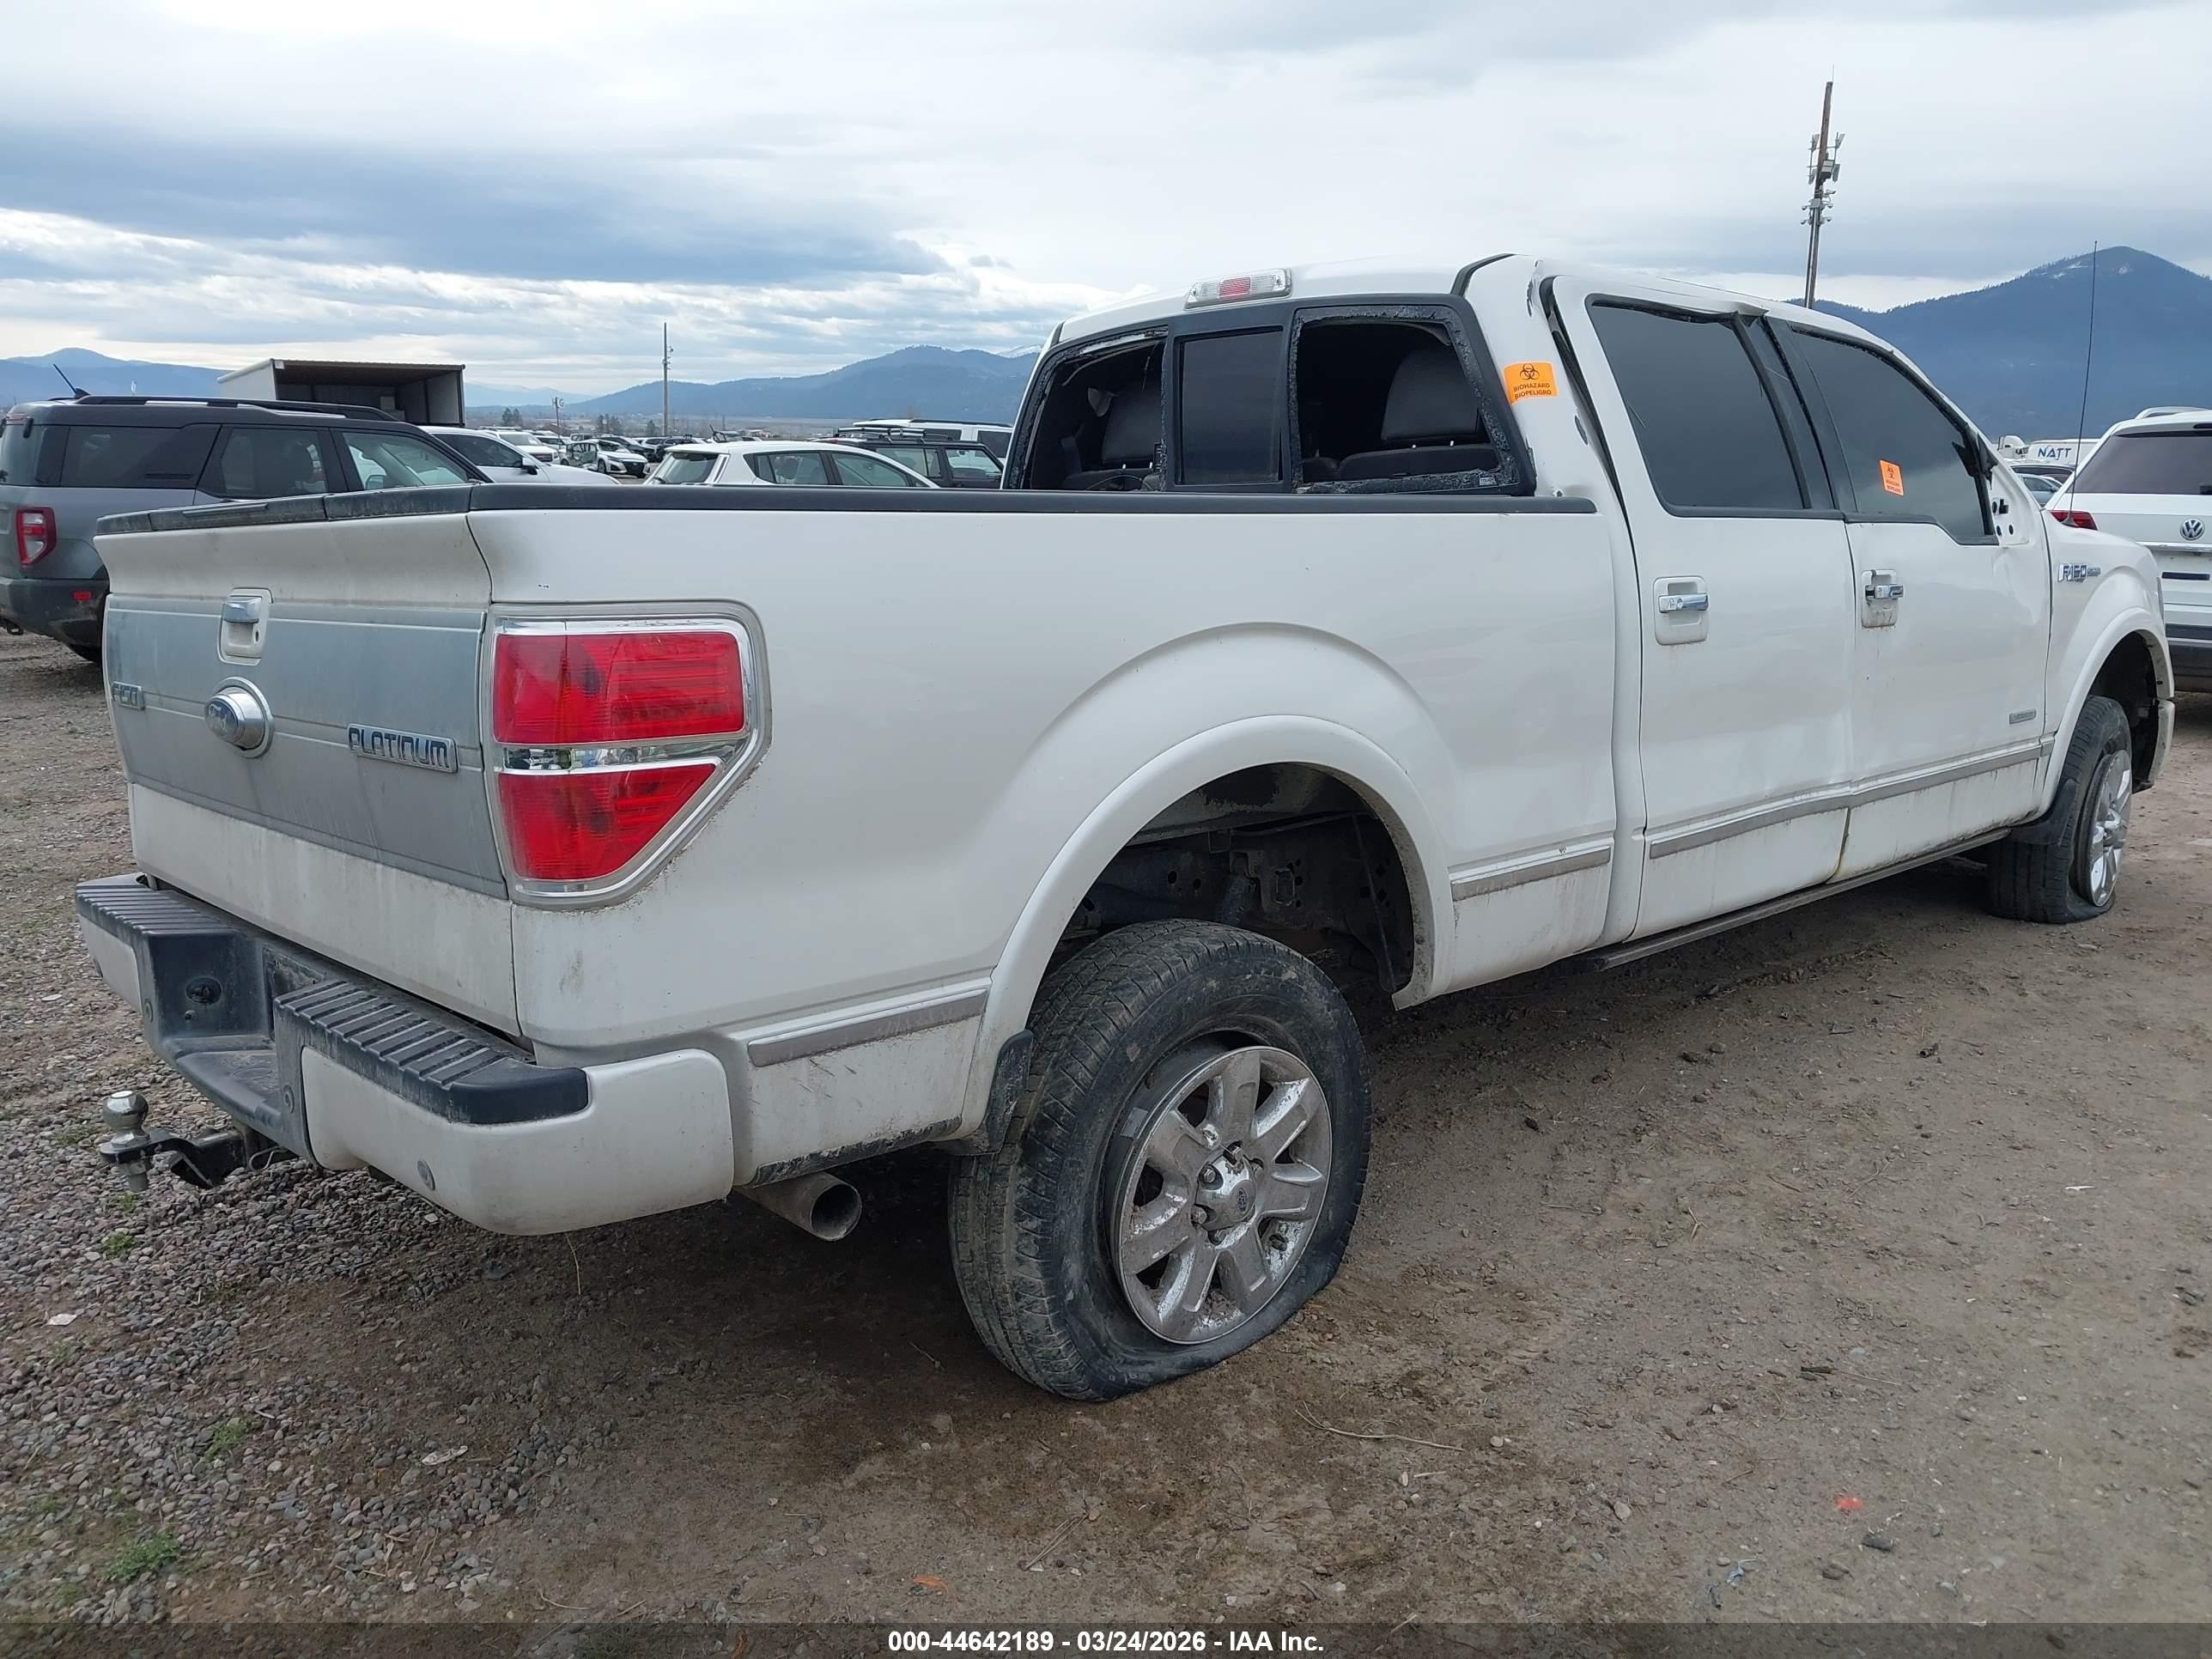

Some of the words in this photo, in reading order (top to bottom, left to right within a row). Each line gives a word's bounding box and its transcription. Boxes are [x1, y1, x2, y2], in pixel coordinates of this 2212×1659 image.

[1514, 383, 1550, 392] BIOHAZARD
[1515, 390, 1552, 399] BIOPELIGRO
[2038, 447, 2071, 461] NATT
[348, 726, 450, 769] PLATINUM
